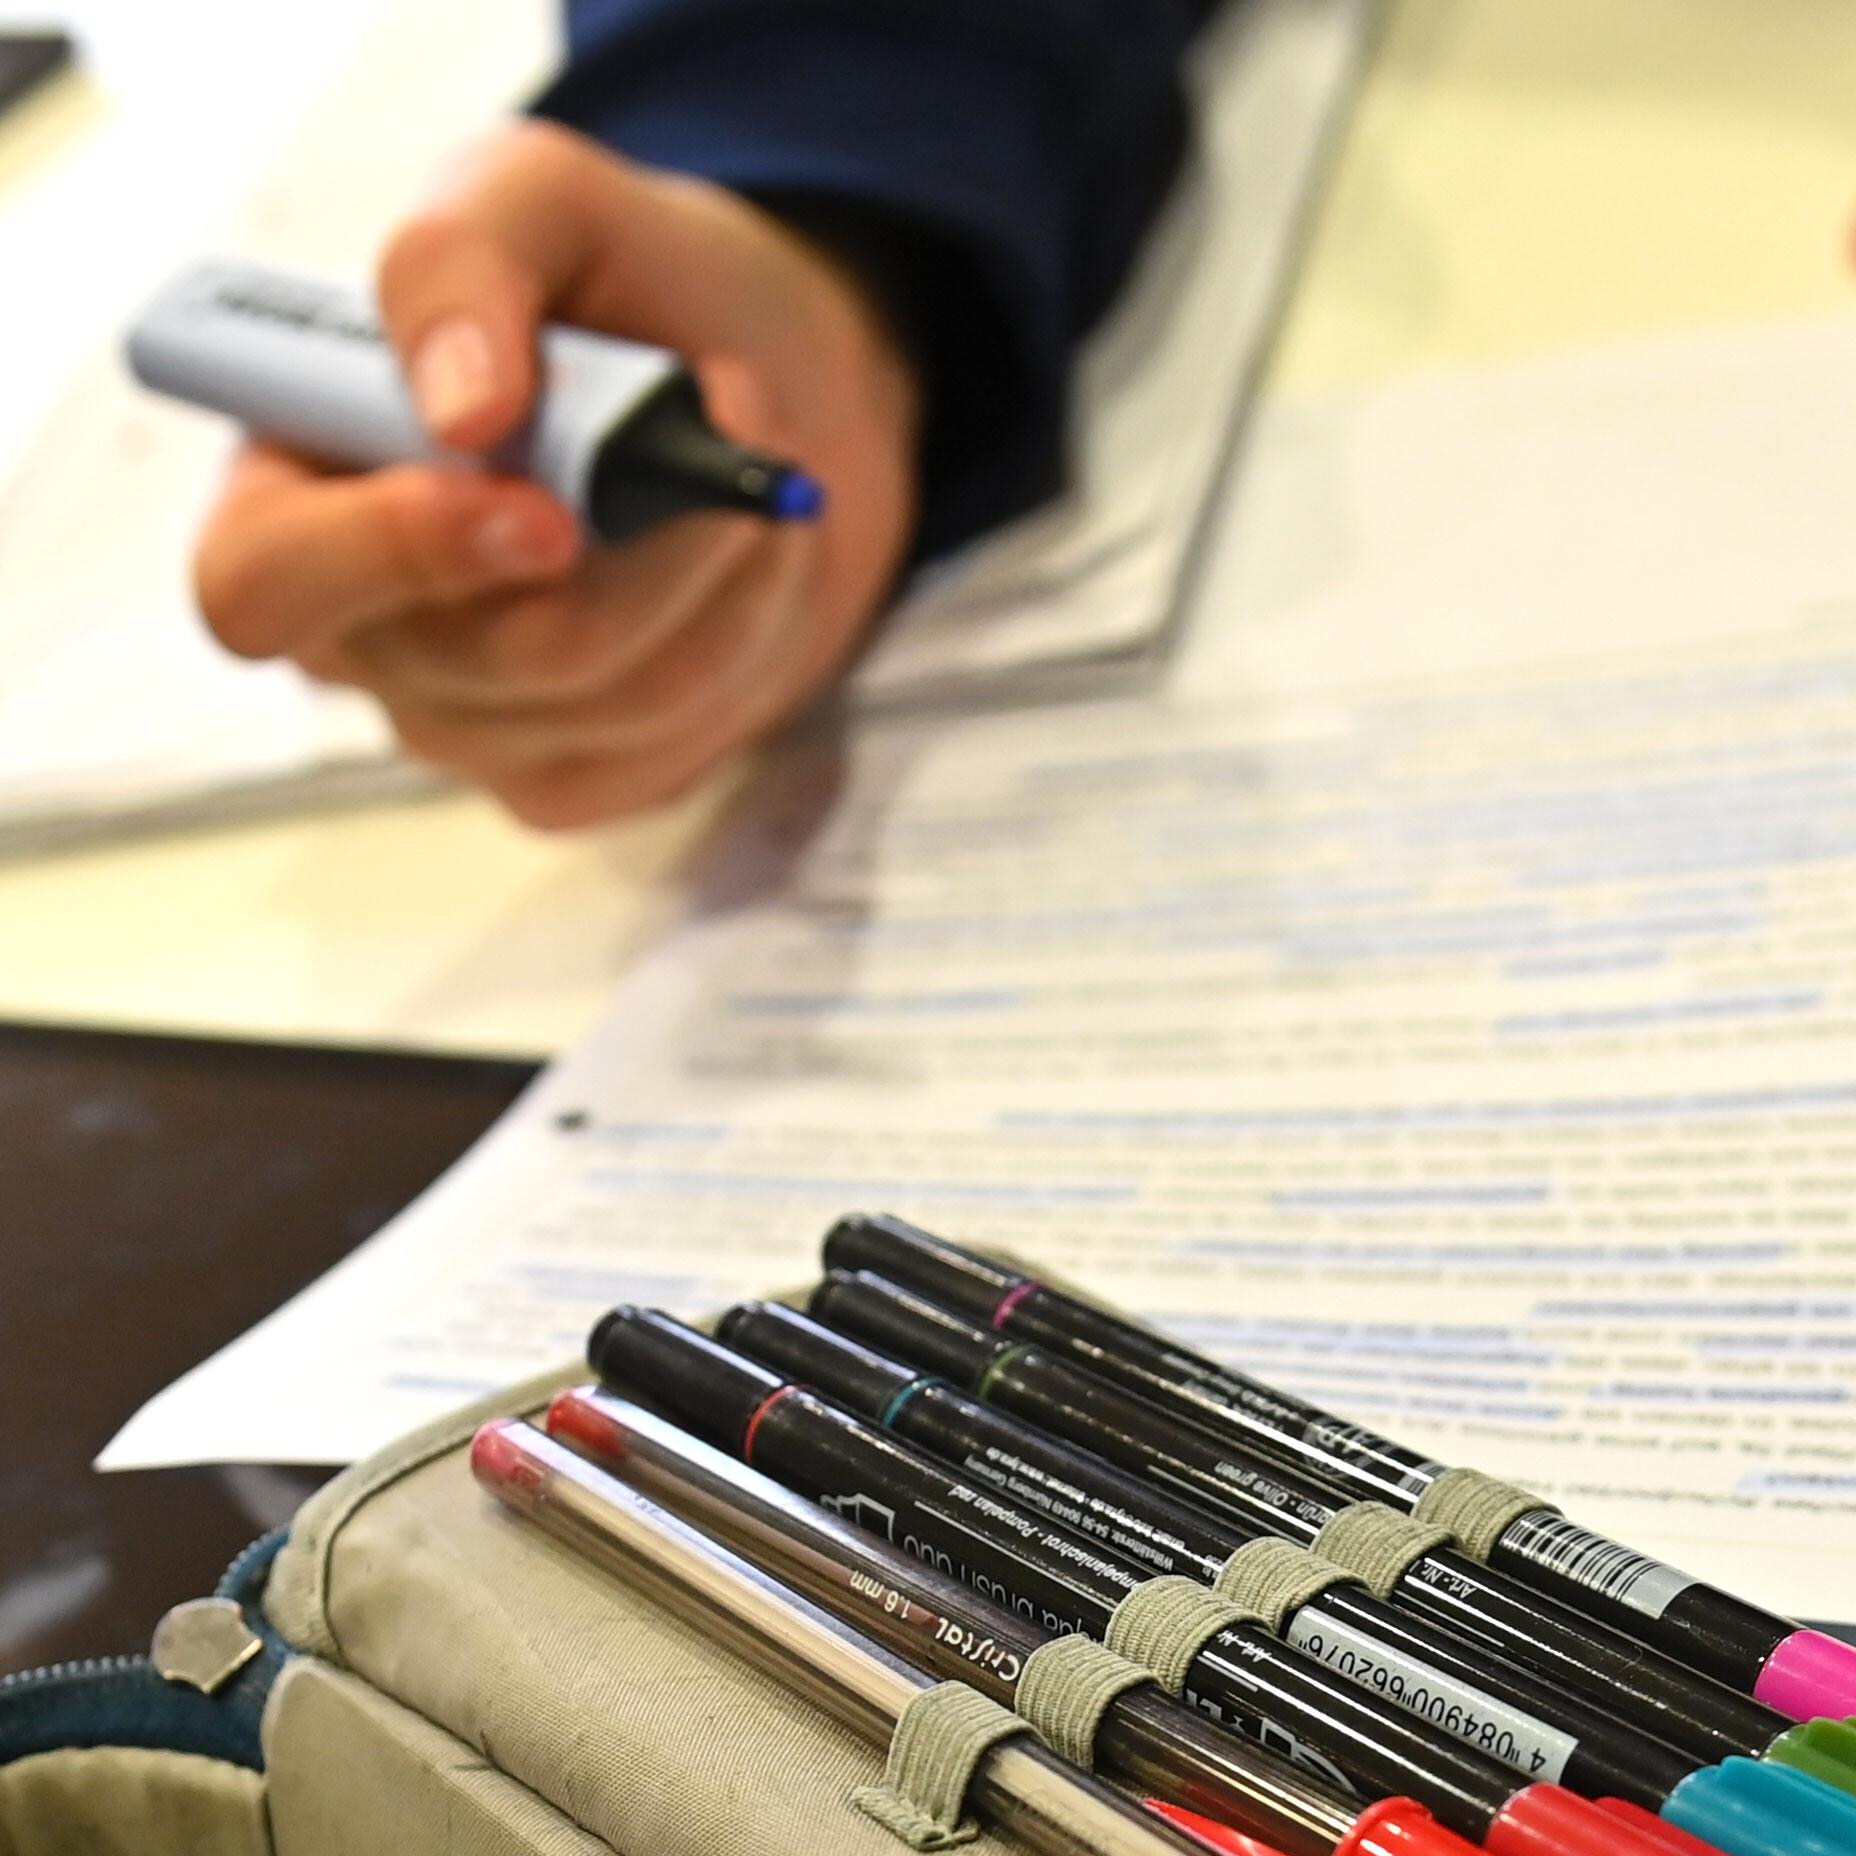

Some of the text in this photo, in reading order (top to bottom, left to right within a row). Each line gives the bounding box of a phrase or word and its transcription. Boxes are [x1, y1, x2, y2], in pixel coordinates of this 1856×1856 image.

[1213, 1459, 1258, 1488] green
[1252, 1479, 1289, 1507] Olive
[1039, 1531, 1141, 1594] ompejanischrot
[847, 1569, 885, 1601] mm
[880, 1589, 915, 1619] 1.6
